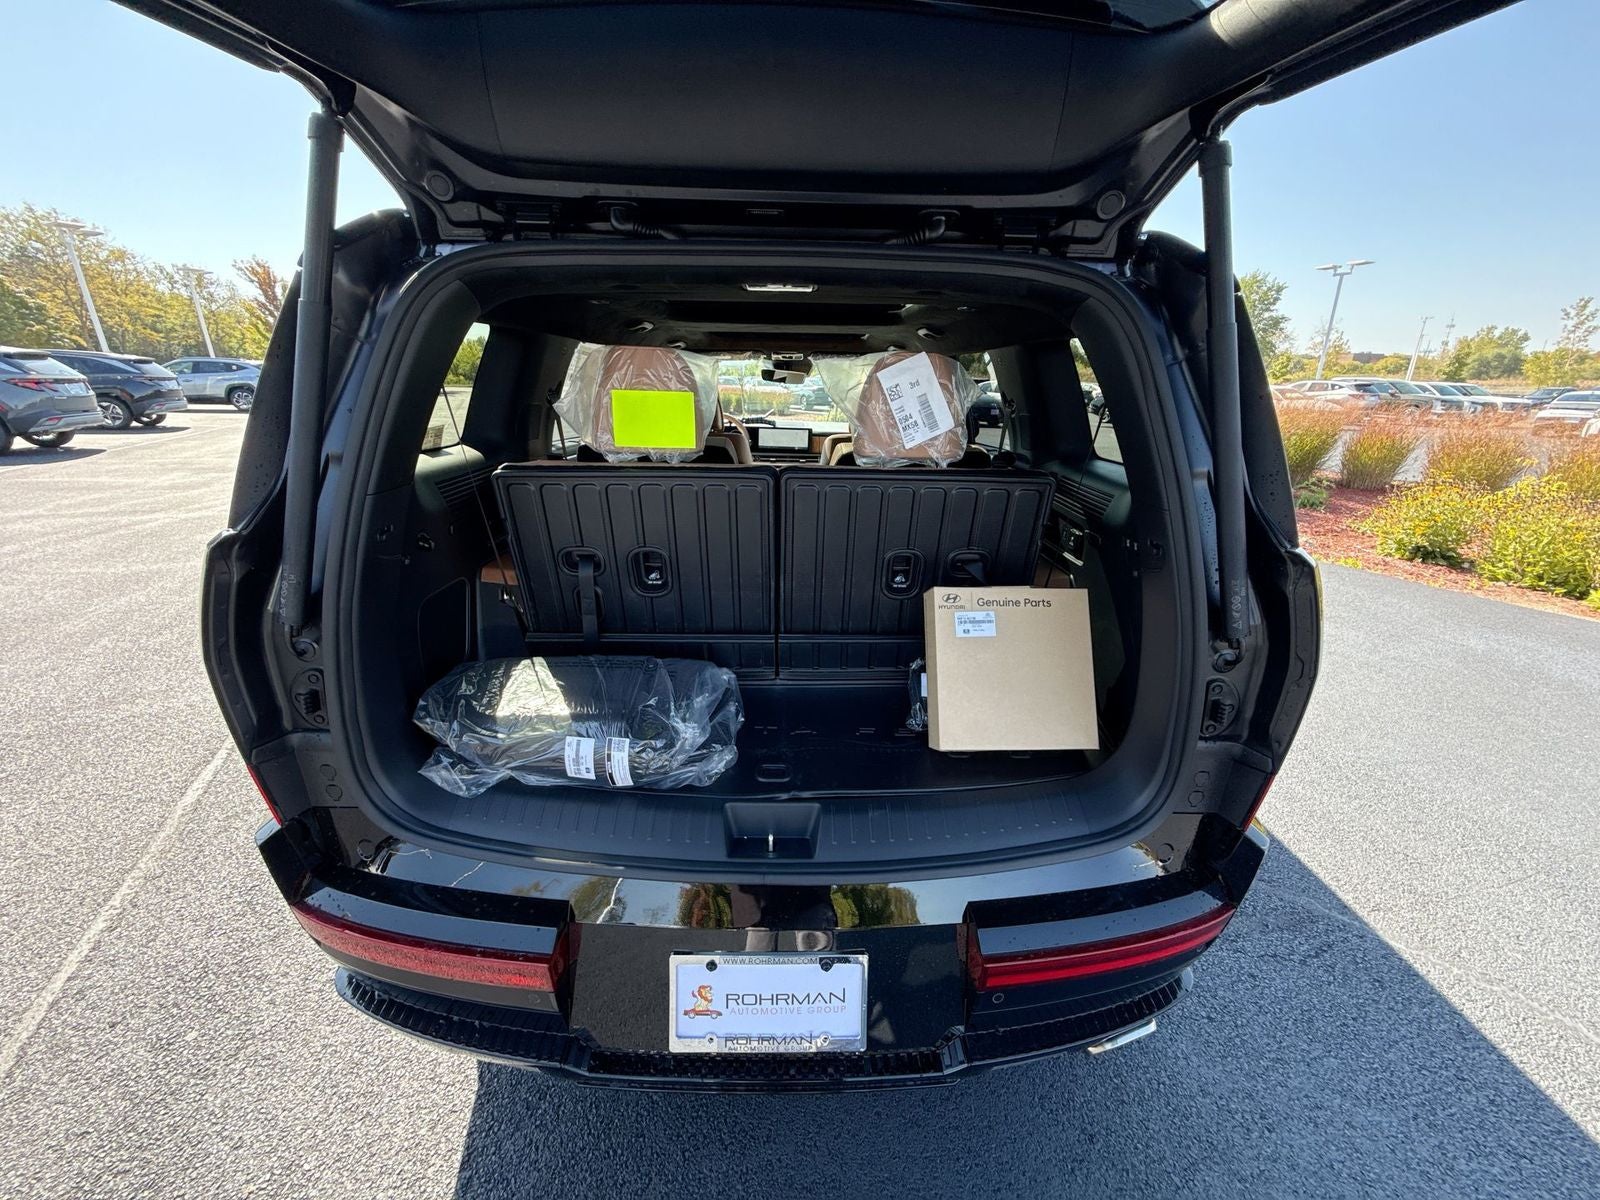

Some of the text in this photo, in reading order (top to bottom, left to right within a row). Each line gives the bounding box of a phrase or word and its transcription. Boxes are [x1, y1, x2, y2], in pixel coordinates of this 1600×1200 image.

[908, 379, 920, 390] 3rd
[976, 597, 1052, 608] Genuine Parts
[723, 957, 818, 965] WWW.ROHRMAN.COM
[726, 987, 846, 1009] ROHRMAN
[729, 1005, 847, 1016] AUTOMOTIVE GROUP
[724, 1033, 813, 1047] ROHRMAN
